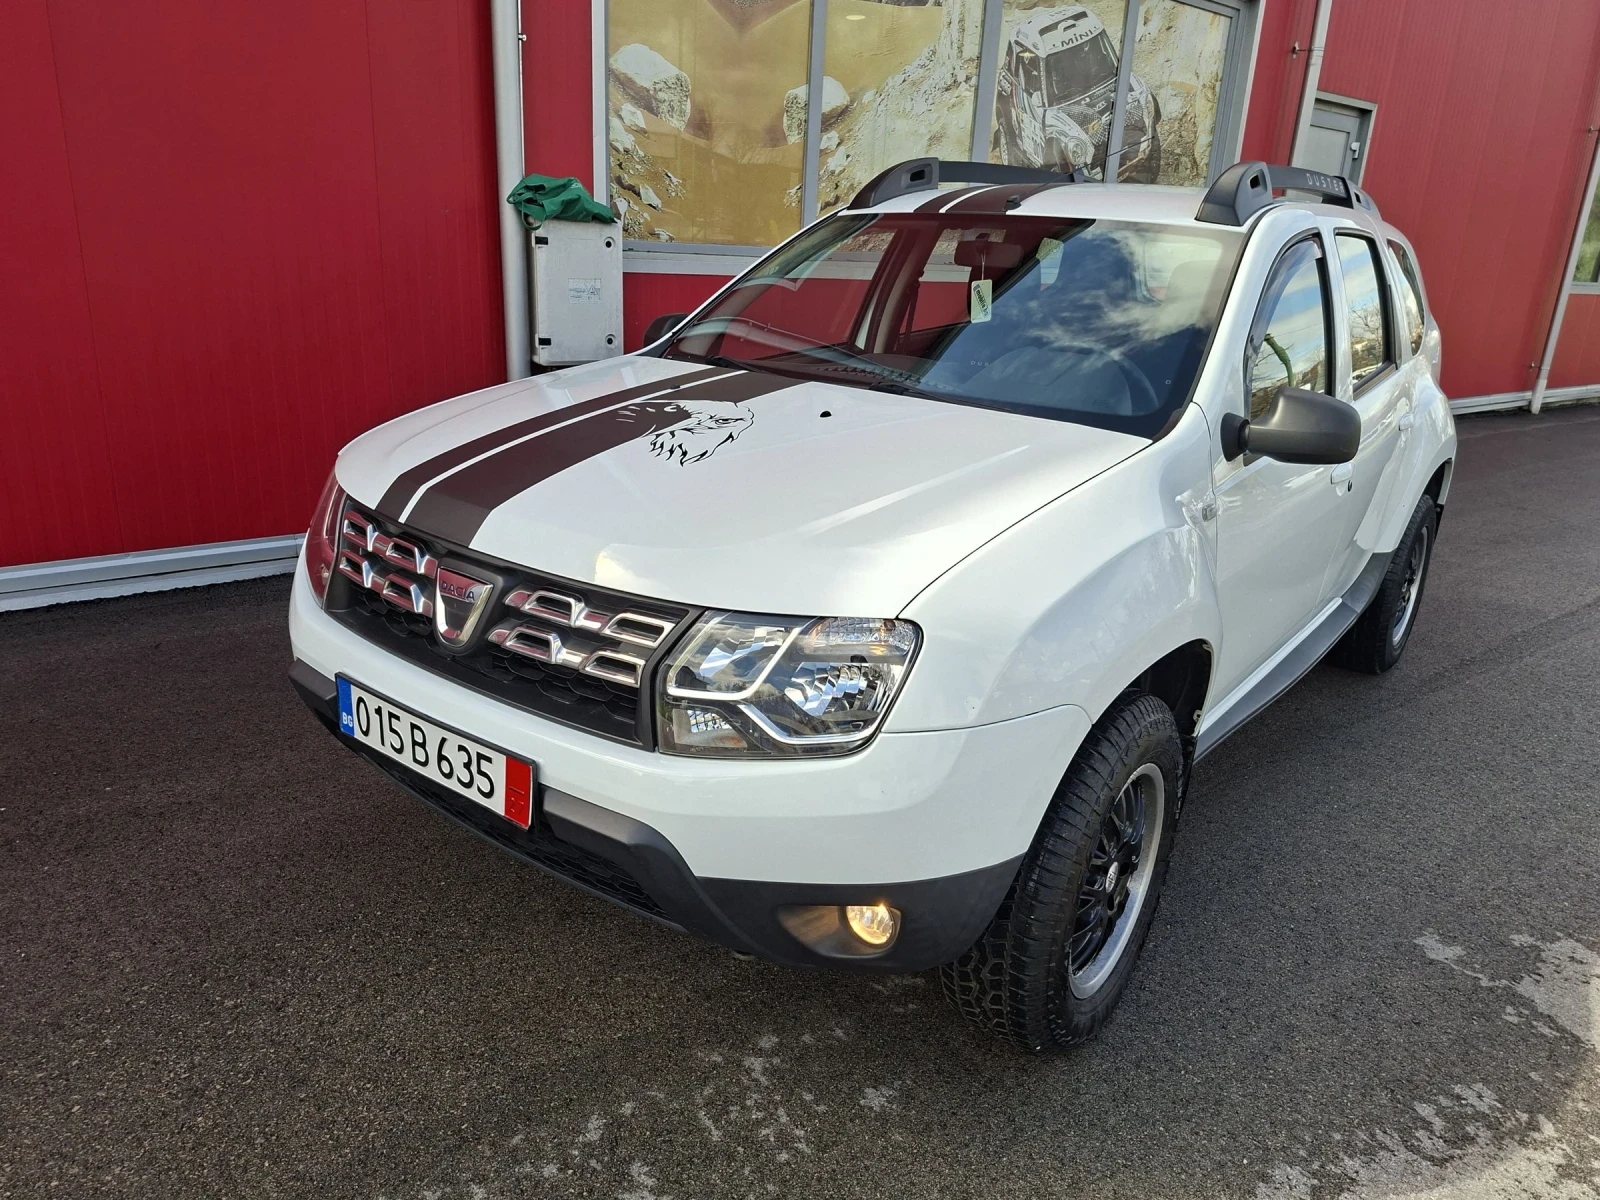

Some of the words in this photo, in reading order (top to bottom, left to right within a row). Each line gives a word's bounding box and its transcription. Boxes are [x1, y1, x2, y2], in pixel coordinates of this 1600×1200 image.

[1061, 29, 1094, 47] MINI
[1306, 173, 1345, 193] DUSTER
[440, 580, 475, 601] DACIA
[342, 712, 353, 727] BG
